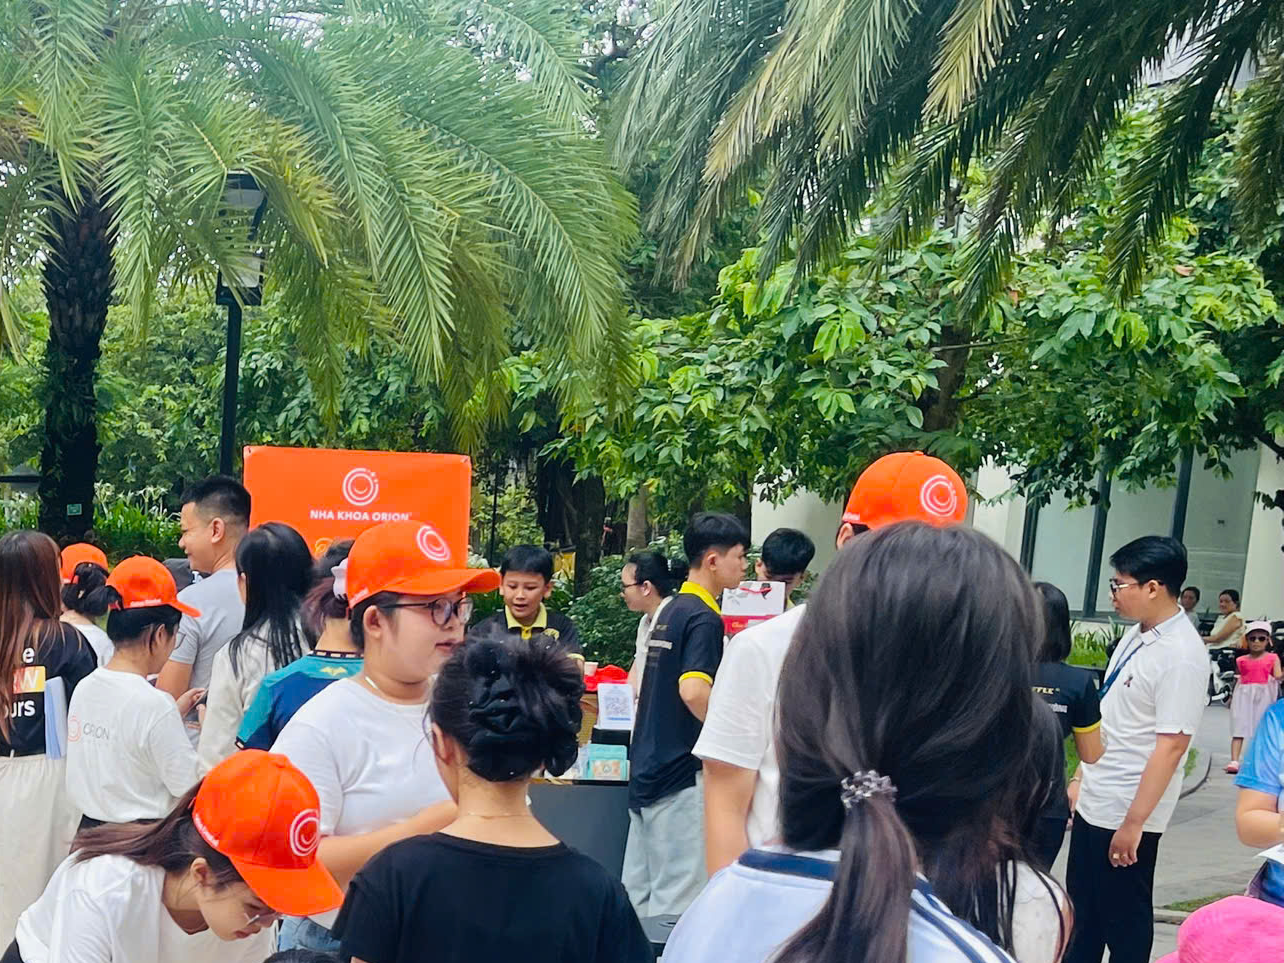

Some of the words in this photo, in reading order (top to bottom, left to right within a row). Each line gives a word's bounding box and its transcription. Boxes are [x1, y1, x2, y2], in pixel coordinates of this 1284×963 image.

[309, 510, 334, 520] NHA
[337, 511, 369, 521] KHOA
[371, 512, 409, 521] ORION
